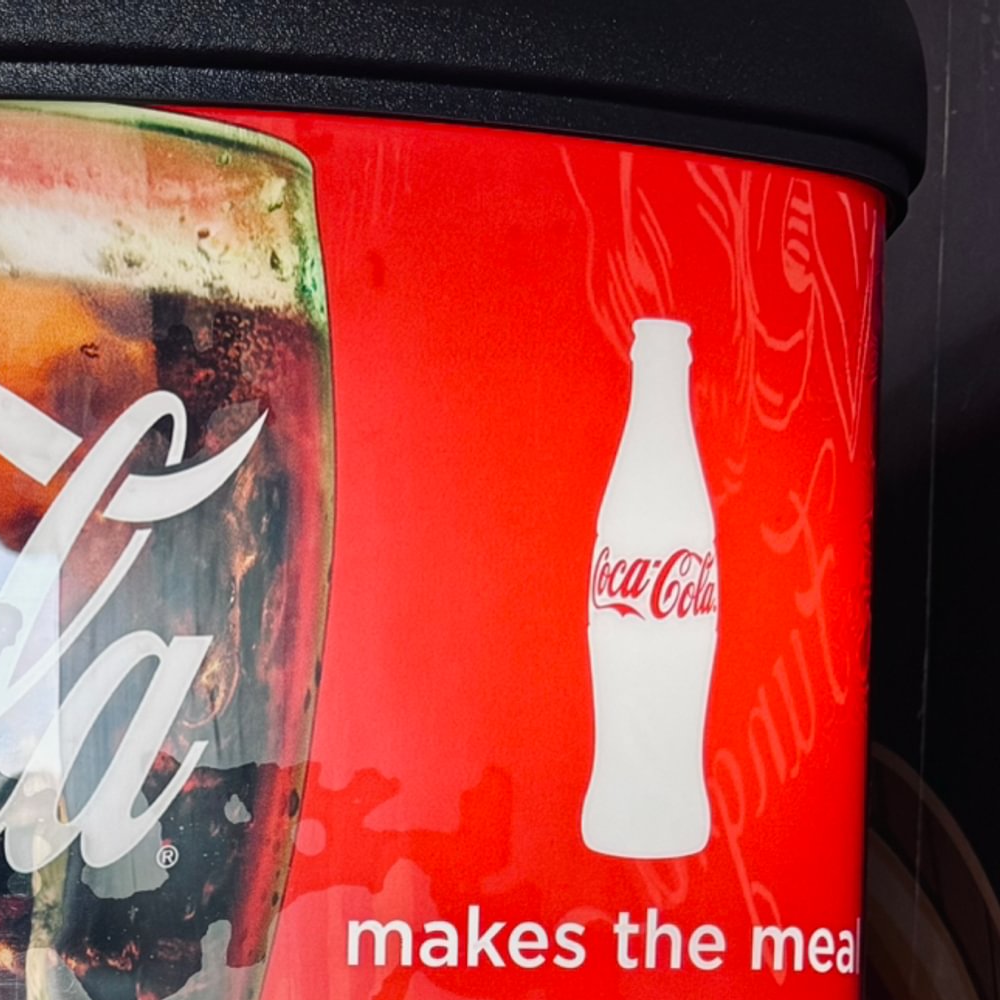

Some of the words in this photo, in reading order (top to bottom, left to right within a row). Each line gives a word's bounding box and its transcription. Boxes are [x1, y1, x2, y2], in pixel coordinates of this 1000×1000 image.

[592, 546, 715, 620] Coca-Cola
[347, 905, 587, 969] makes
[614, 908, 726, 971] the
